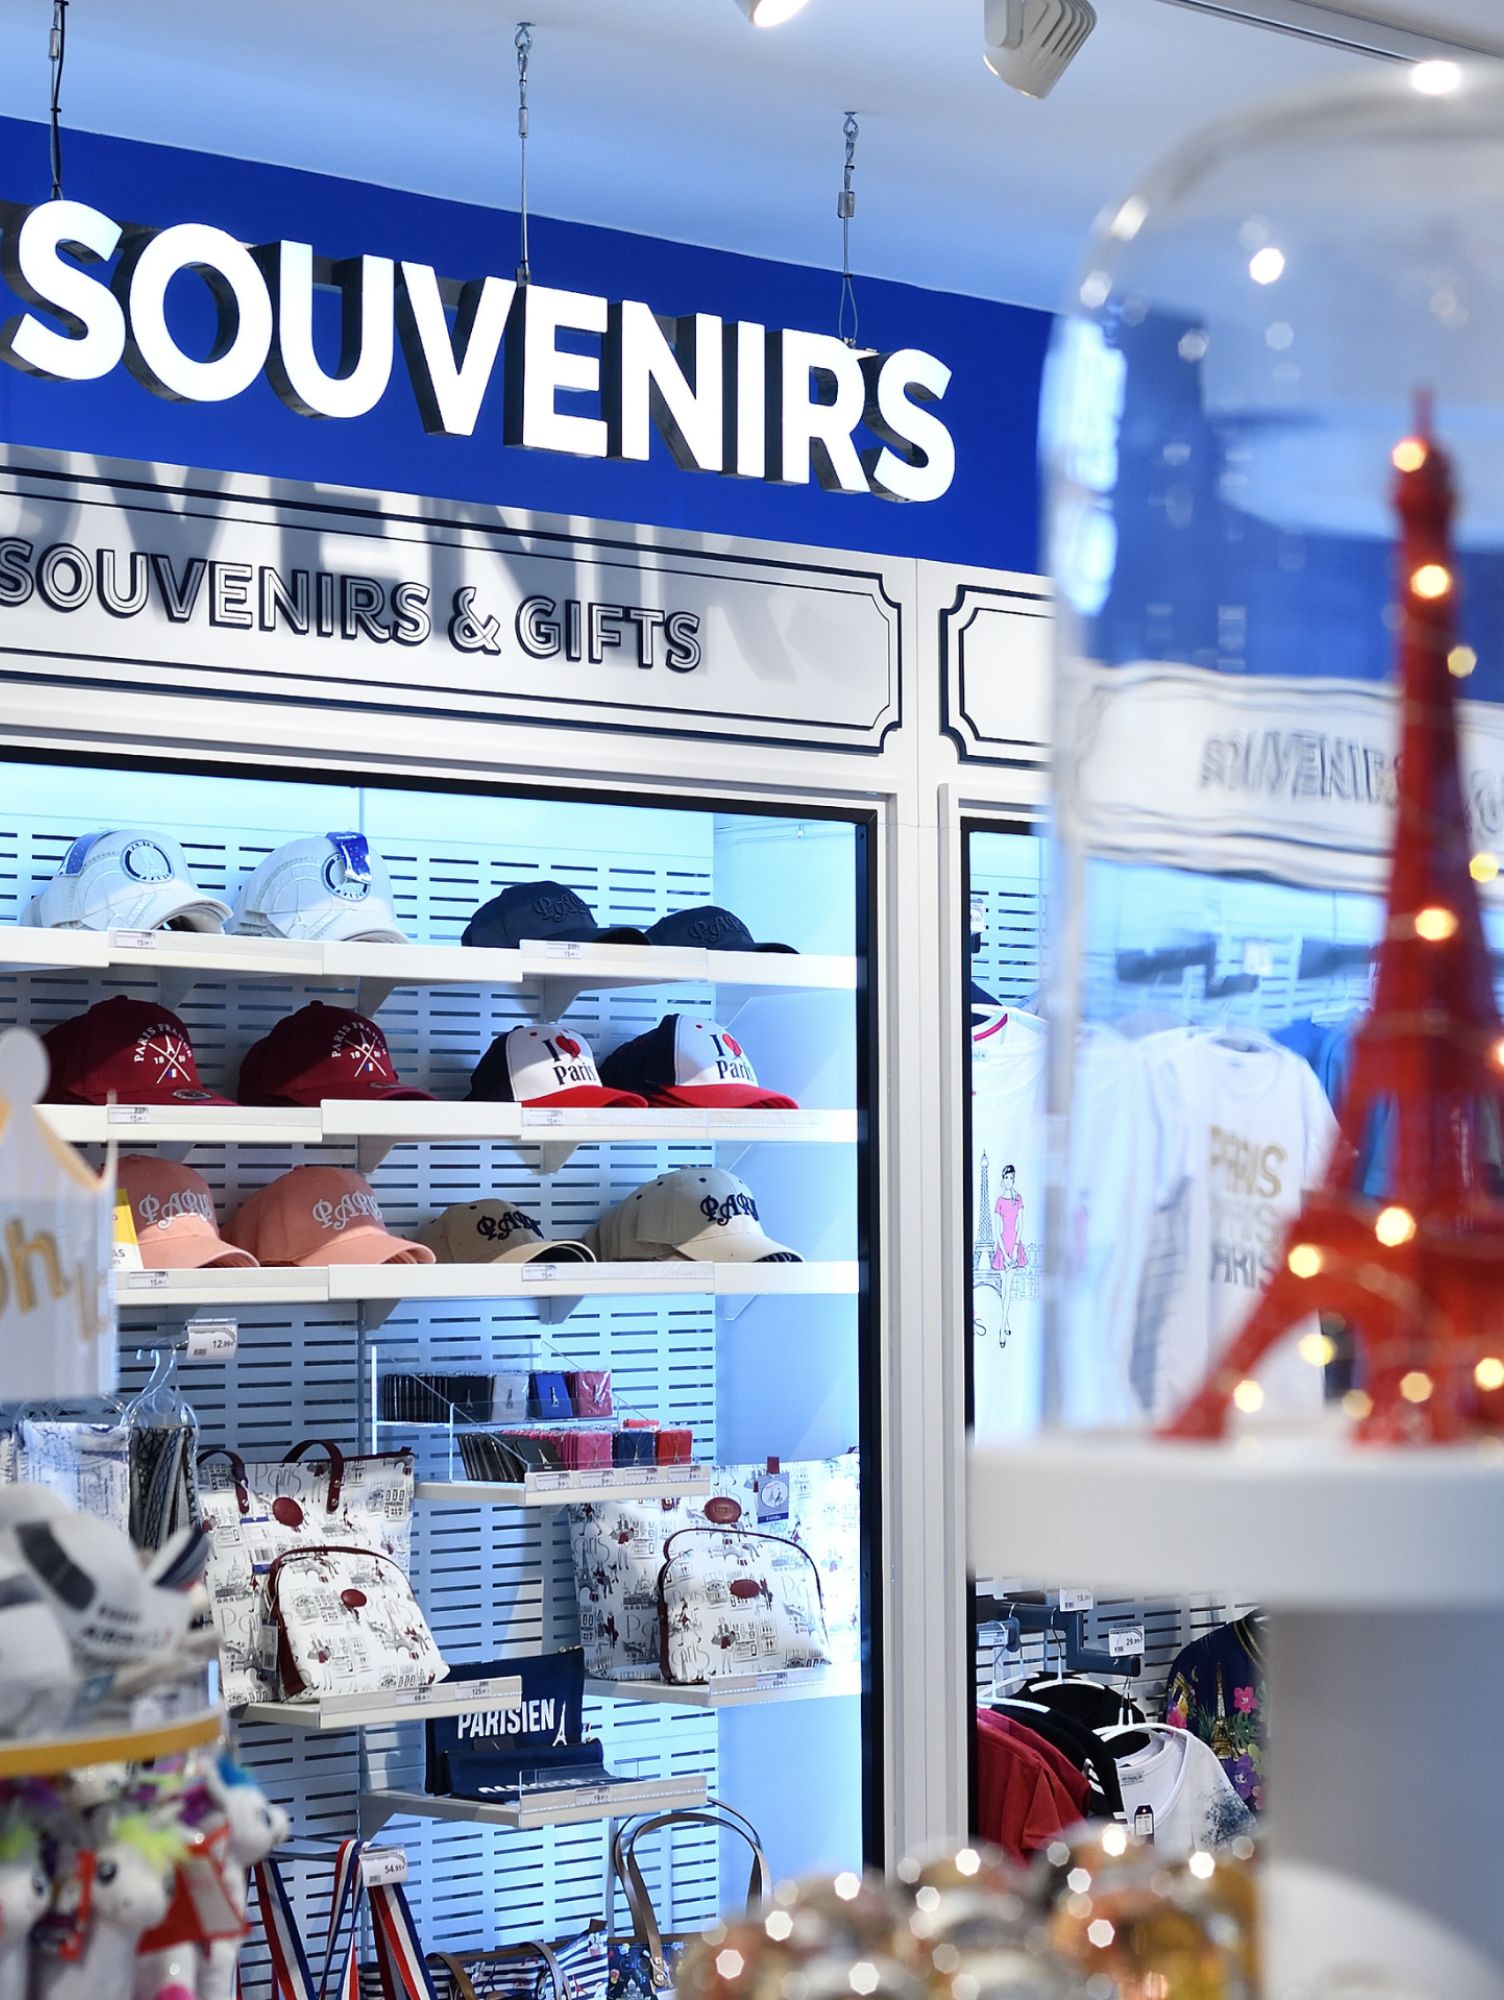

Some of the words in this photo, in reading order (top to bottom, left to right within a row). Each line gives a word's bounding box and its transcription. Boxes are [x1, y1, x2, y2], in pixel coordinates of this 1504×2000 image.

[8, 200, 955, 503] SOUVENIRS
[0, 536, 431, 647] SOUVENIRS
[449, 586, 501, 655] &
[515, 594, 702, 674] GIFTS
[134, 1026, 157, 1063] PARIS
[542, 1039, 561, 1063] I
[710, 1034, 726, 1056] I
[457, 1698, 556, 1739] PARISIEN
